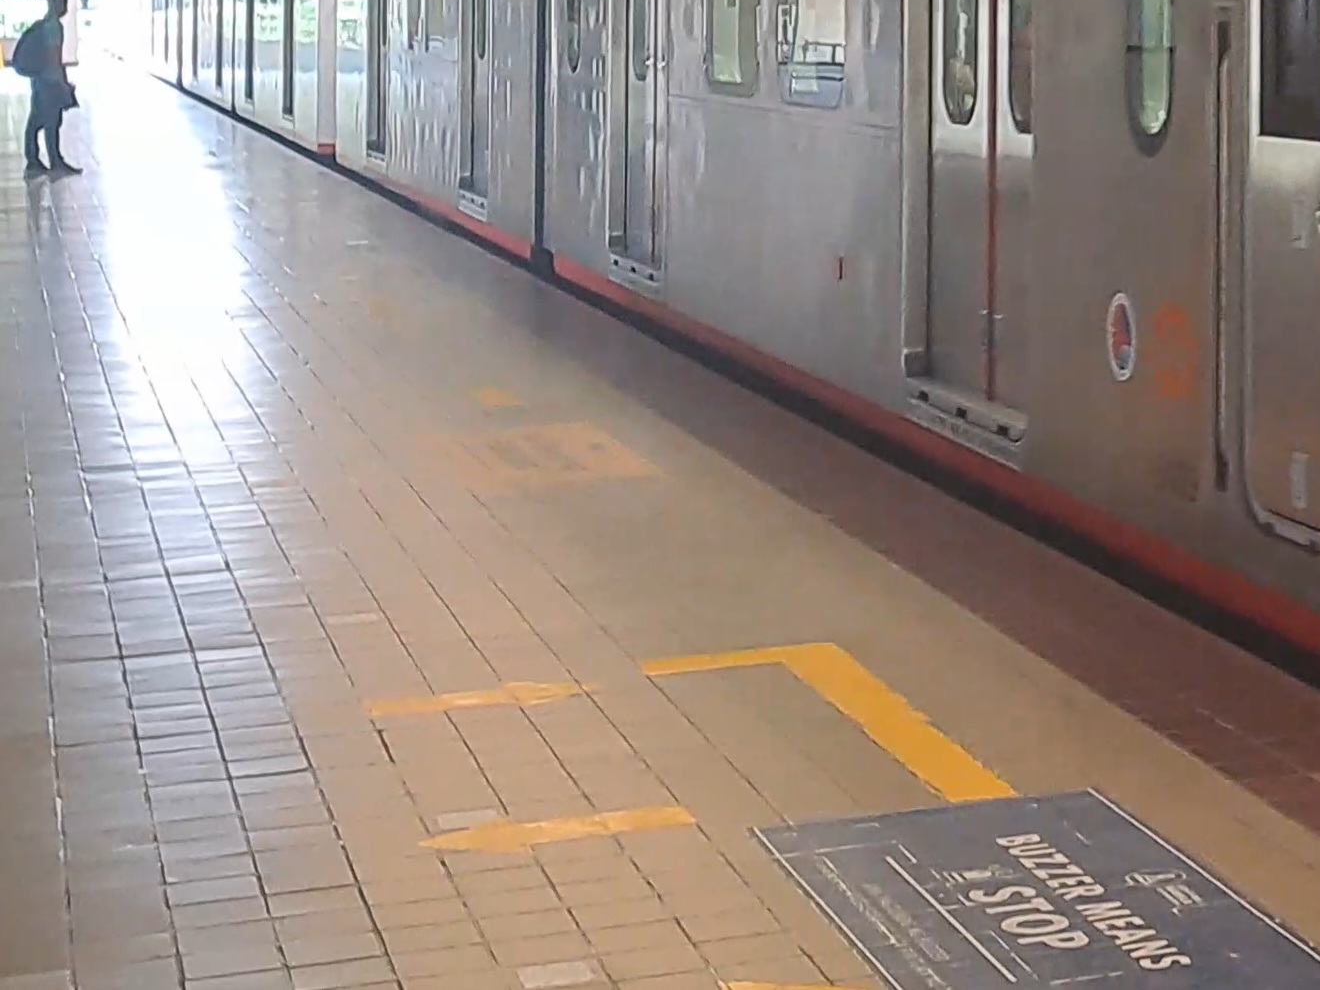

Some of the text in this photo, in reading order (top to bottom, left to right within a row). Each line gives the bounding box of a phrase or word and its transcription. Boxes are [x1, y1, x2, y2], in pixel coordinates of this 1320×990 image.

[968, 885, 1090, 950] STOP
[995, 833, 1105, 902] BUZZER
[1075, 900, 1192, 971] MEANS
